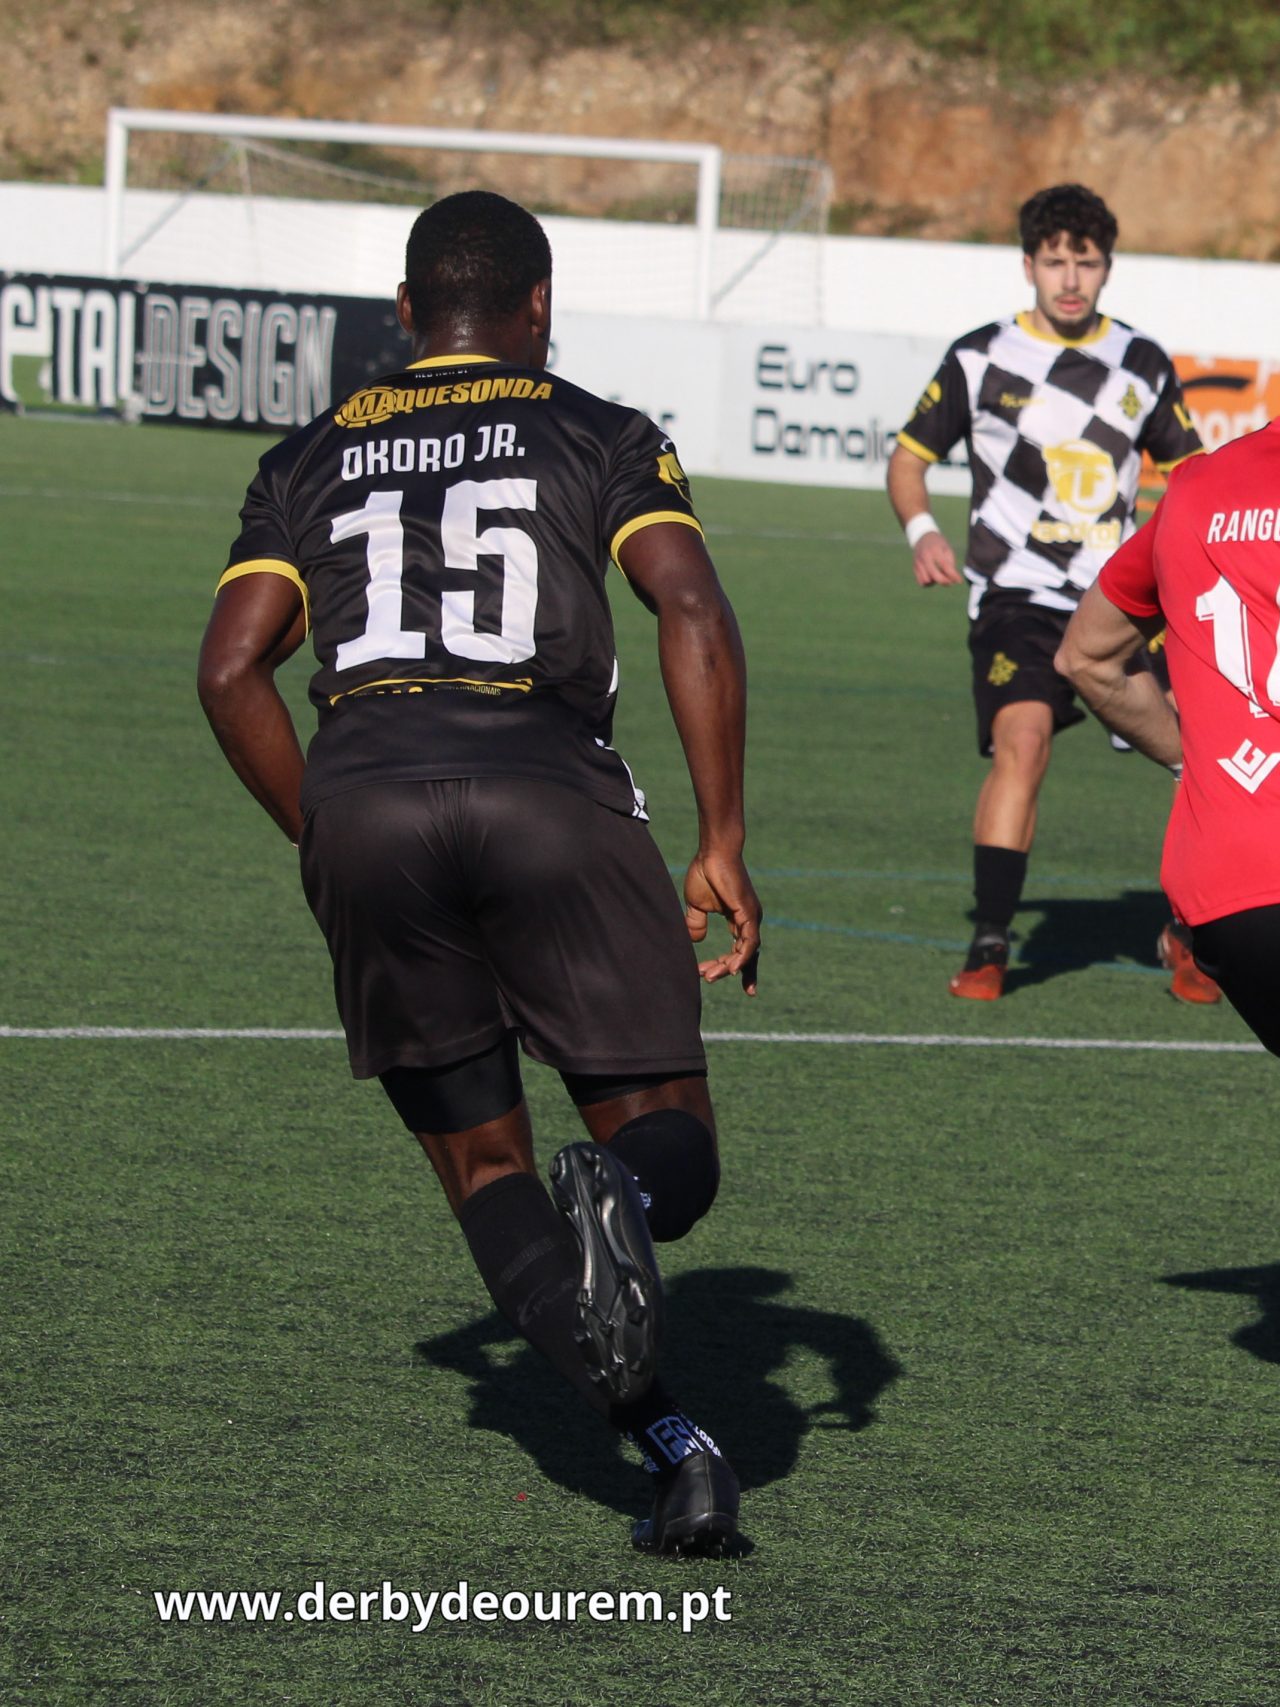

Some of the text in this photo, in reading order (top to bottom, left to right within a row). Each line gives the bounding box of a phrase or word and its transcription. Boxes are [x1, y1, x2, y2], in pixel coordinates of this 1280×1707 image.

[756, 343, 859, 396] Euro
[346, 377, 553, 421] MAQUESONDA
[341, 422, 526, 482] OKORO JR.
[329, 477, 540, 672] 15
